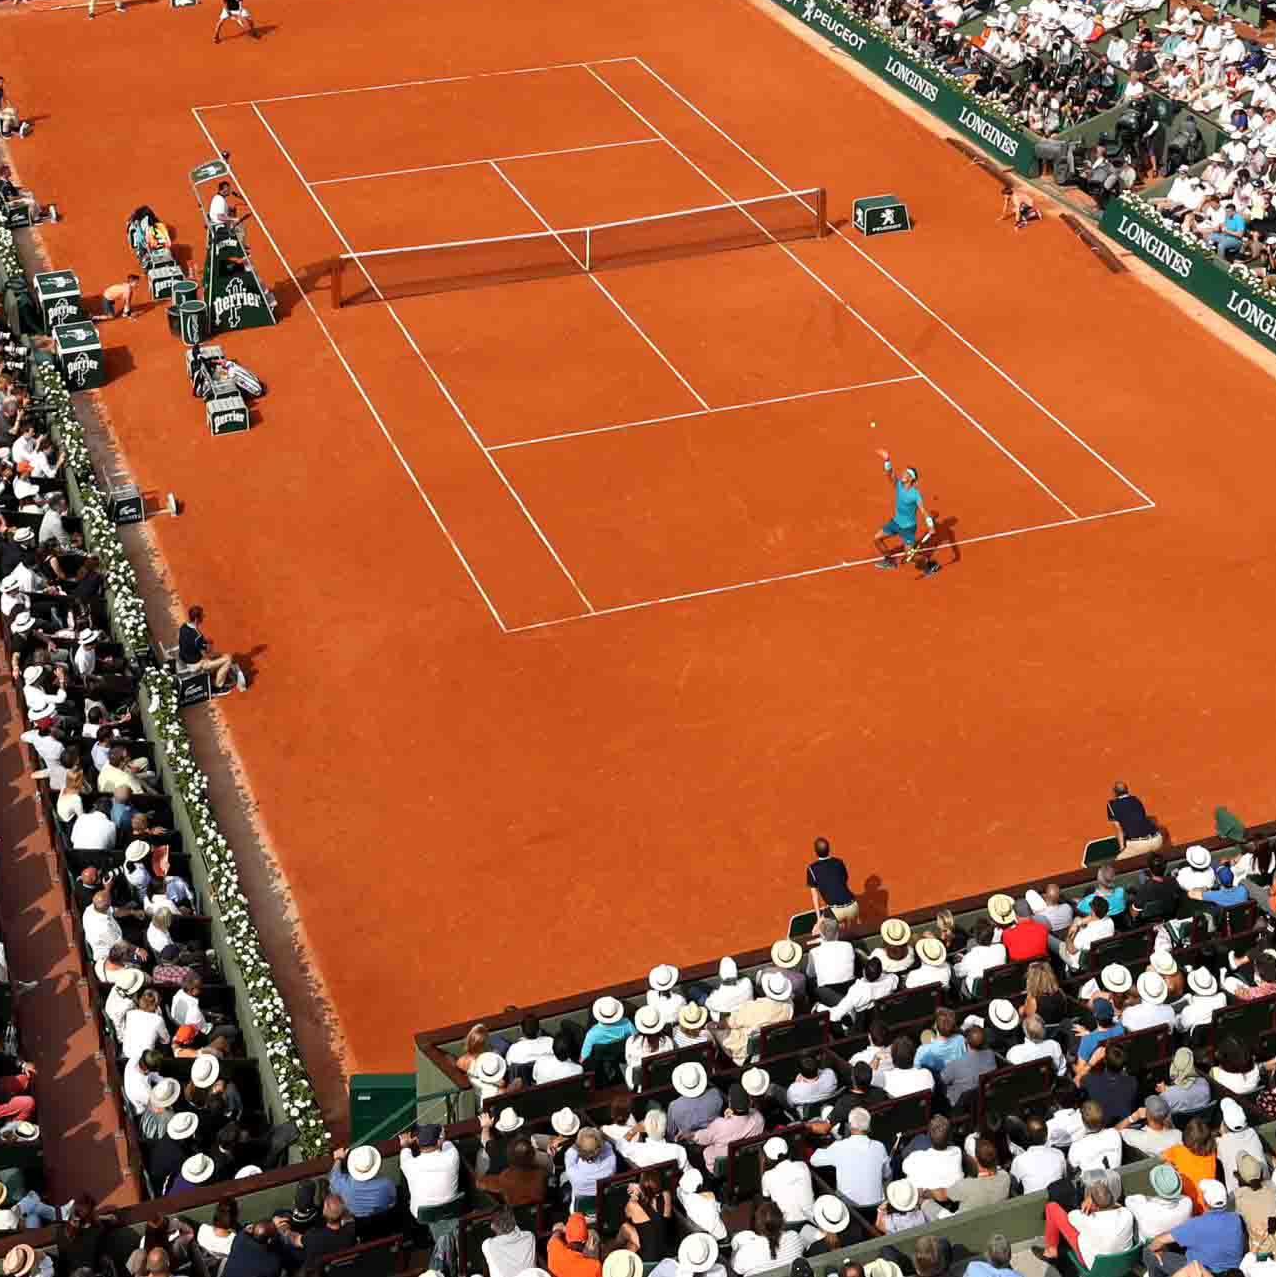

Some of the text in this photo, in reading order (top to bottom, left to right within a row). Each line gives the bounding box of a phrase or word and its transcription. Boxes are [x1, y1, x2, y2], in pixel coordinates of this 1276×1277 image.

[812, 8, 867, 51] PEUGEOT
[884, 55, 939, 103] LONGINES
[958, 105, 1020, 157] LONGINES
[1116, 215, 1193, 278] LONGINES
[48, 304, 78, 325] perrier
[213, 287, 261, 325] perrier
[67, 359, 99, 381] perrier
[214, 410, 245, 433] perrier
